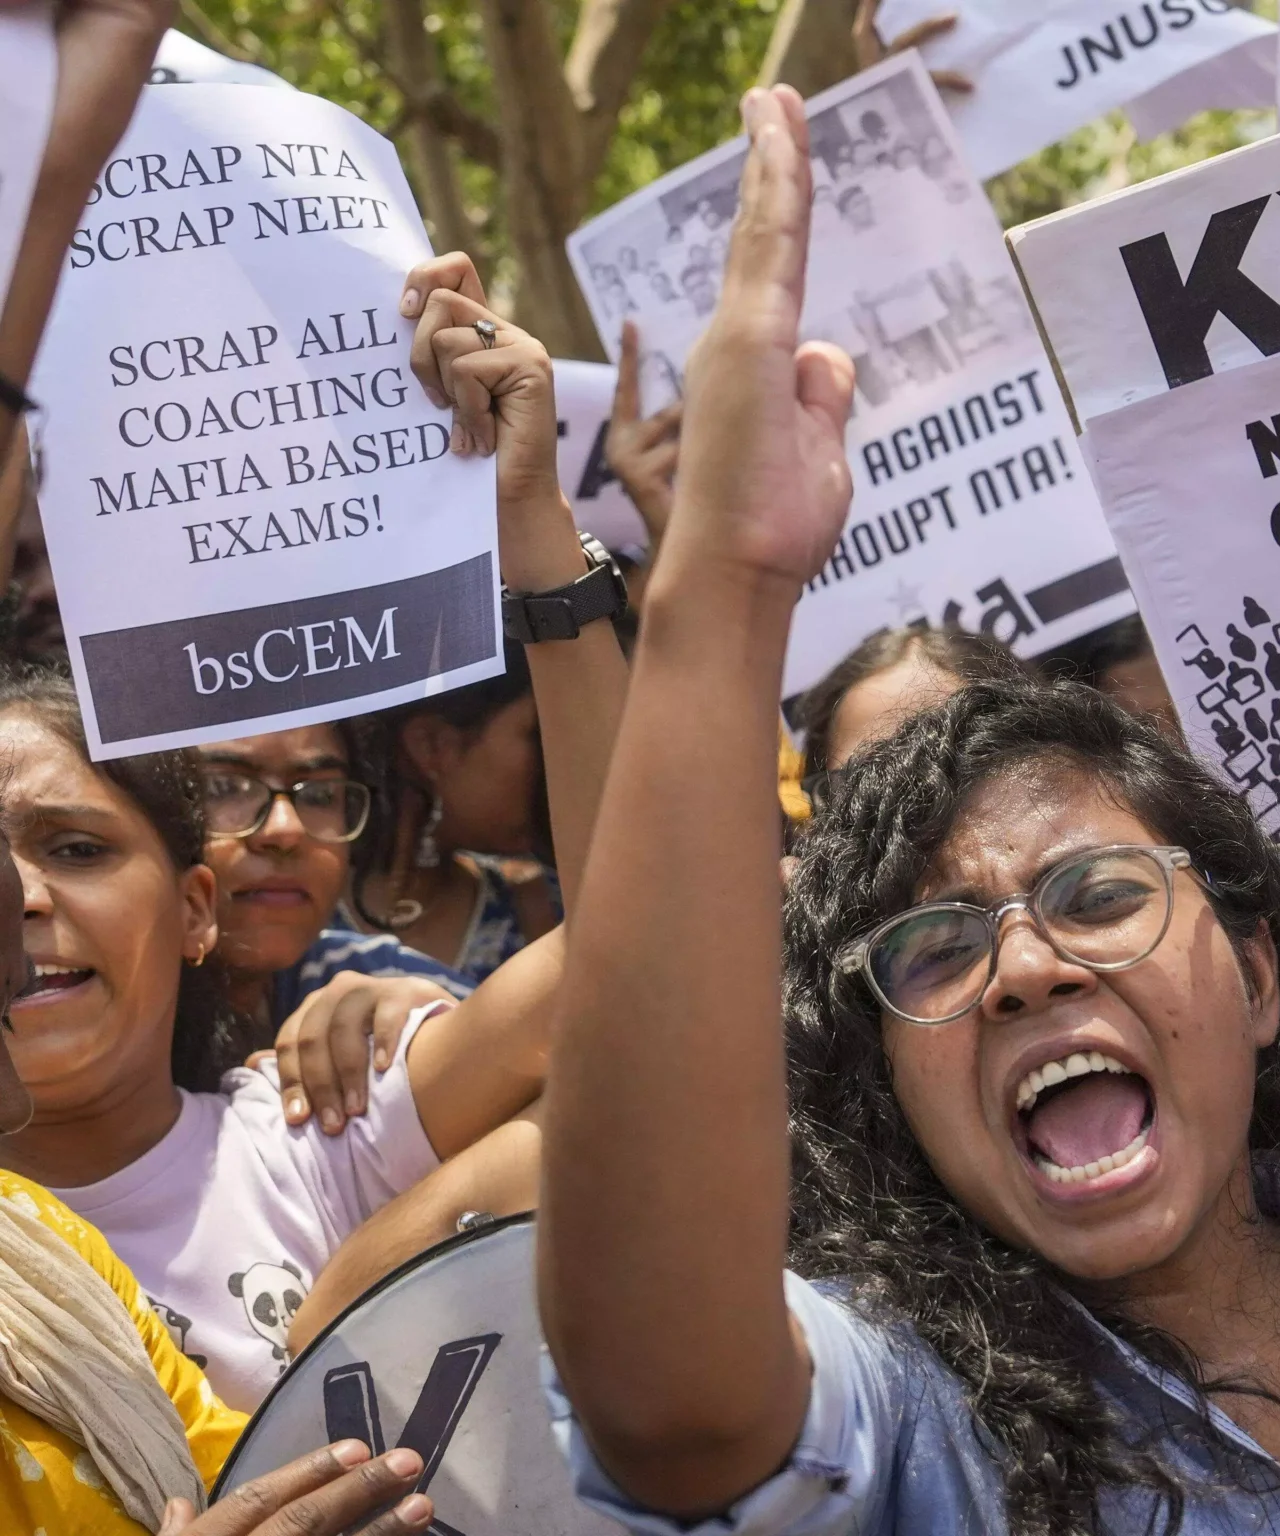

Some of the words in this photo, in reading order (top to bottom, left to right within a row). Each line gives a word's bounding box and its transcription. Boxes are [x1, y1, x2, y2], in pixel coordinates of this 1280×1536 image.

[256, 143, 368, 181] NTA
[70, 206, 235, 269] SCRAP
[248, 196, 389, 239] NEET
[109, 324, 279, 387] SCRAP
[296, 308, 398, 359] ALL
[118, 367, 409, 447] COACHING
[862, 369, 1046, 486] AGAINST
[90, 453, 272, 516] MAFIA
[280, 422, 451, 486] BASED
[969, 437, 1075, 516] NTA!
[182, 494, 385, 564] EXAMS!
[183, 607, 401, 695] bsCEM
